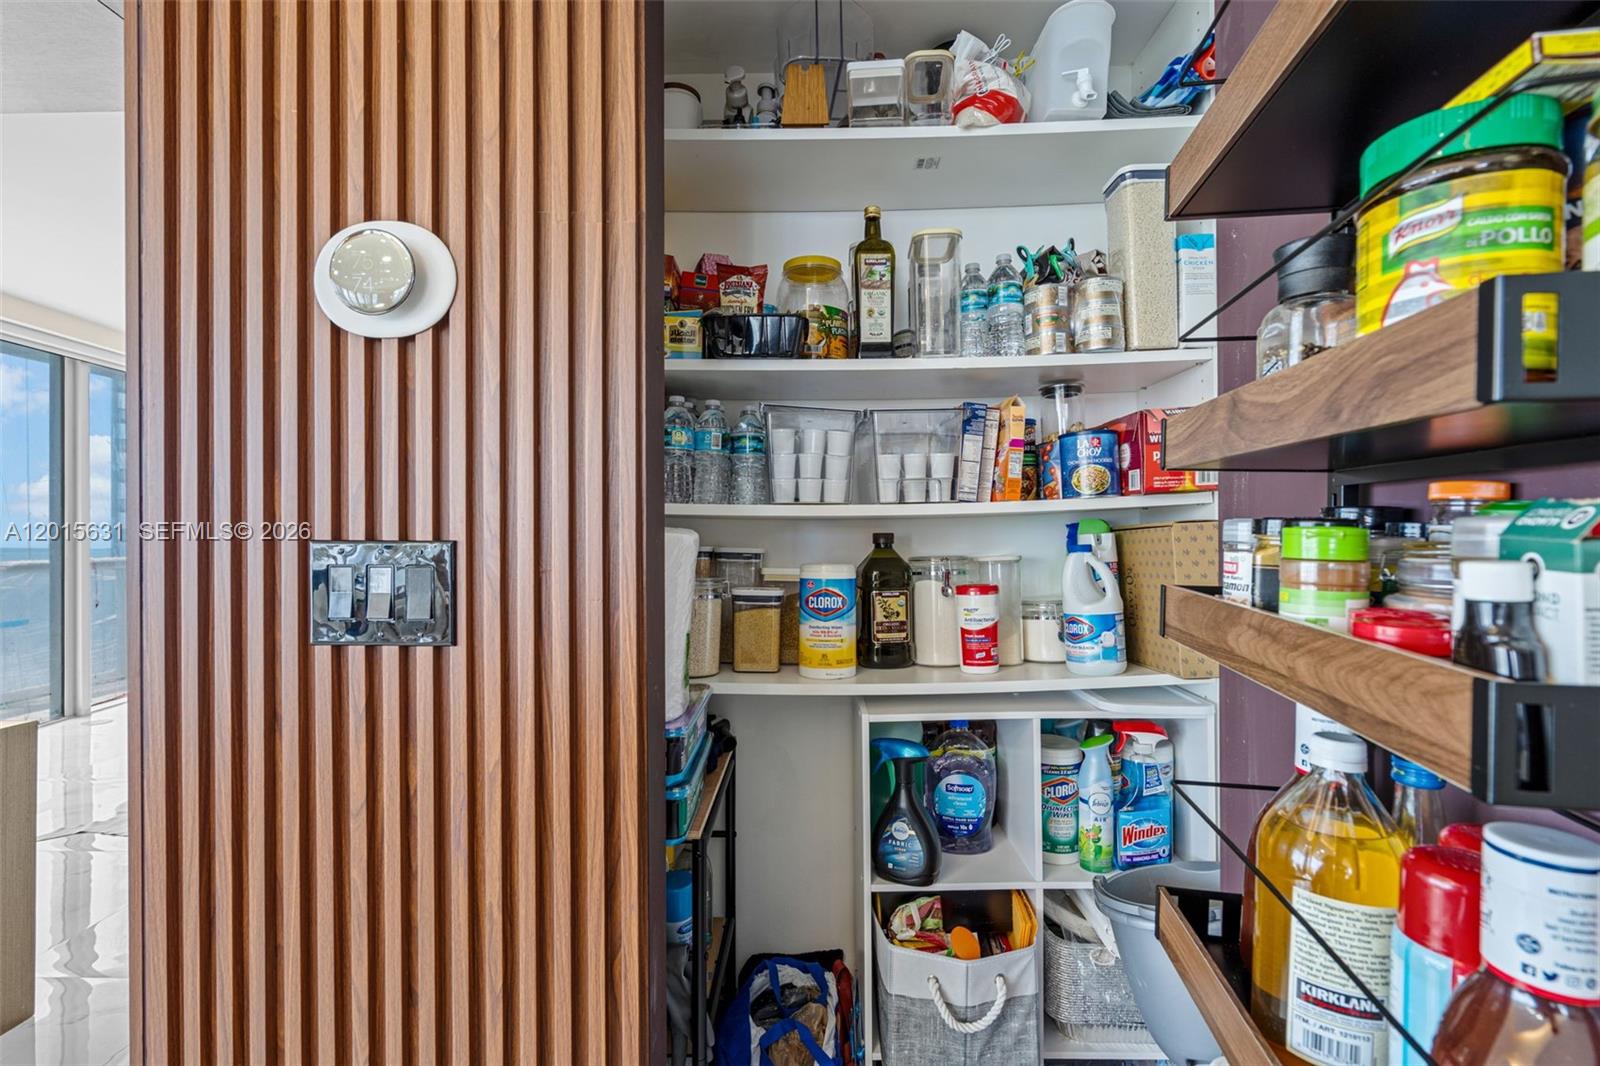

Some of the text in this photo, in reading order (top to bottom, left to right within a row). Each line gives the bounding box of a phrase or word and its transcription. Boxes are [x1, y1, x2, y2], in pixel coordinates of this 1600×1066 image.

[1394, 210, 1457, 243] Knorr
[1480, 226, 1553, 246] POLLO
[1077, 439, 1090, 448] LA
[1077, 446, 1102, 458] CHOY
[808, 594, 843, 608] CLOROX
[946, 784, 974, 793] Softsoap
[1044, 782, 1078, 798] CLOROX
[1122, 824, 1168, 848] Windex
[888, 839, 913, 848] FABRIC
